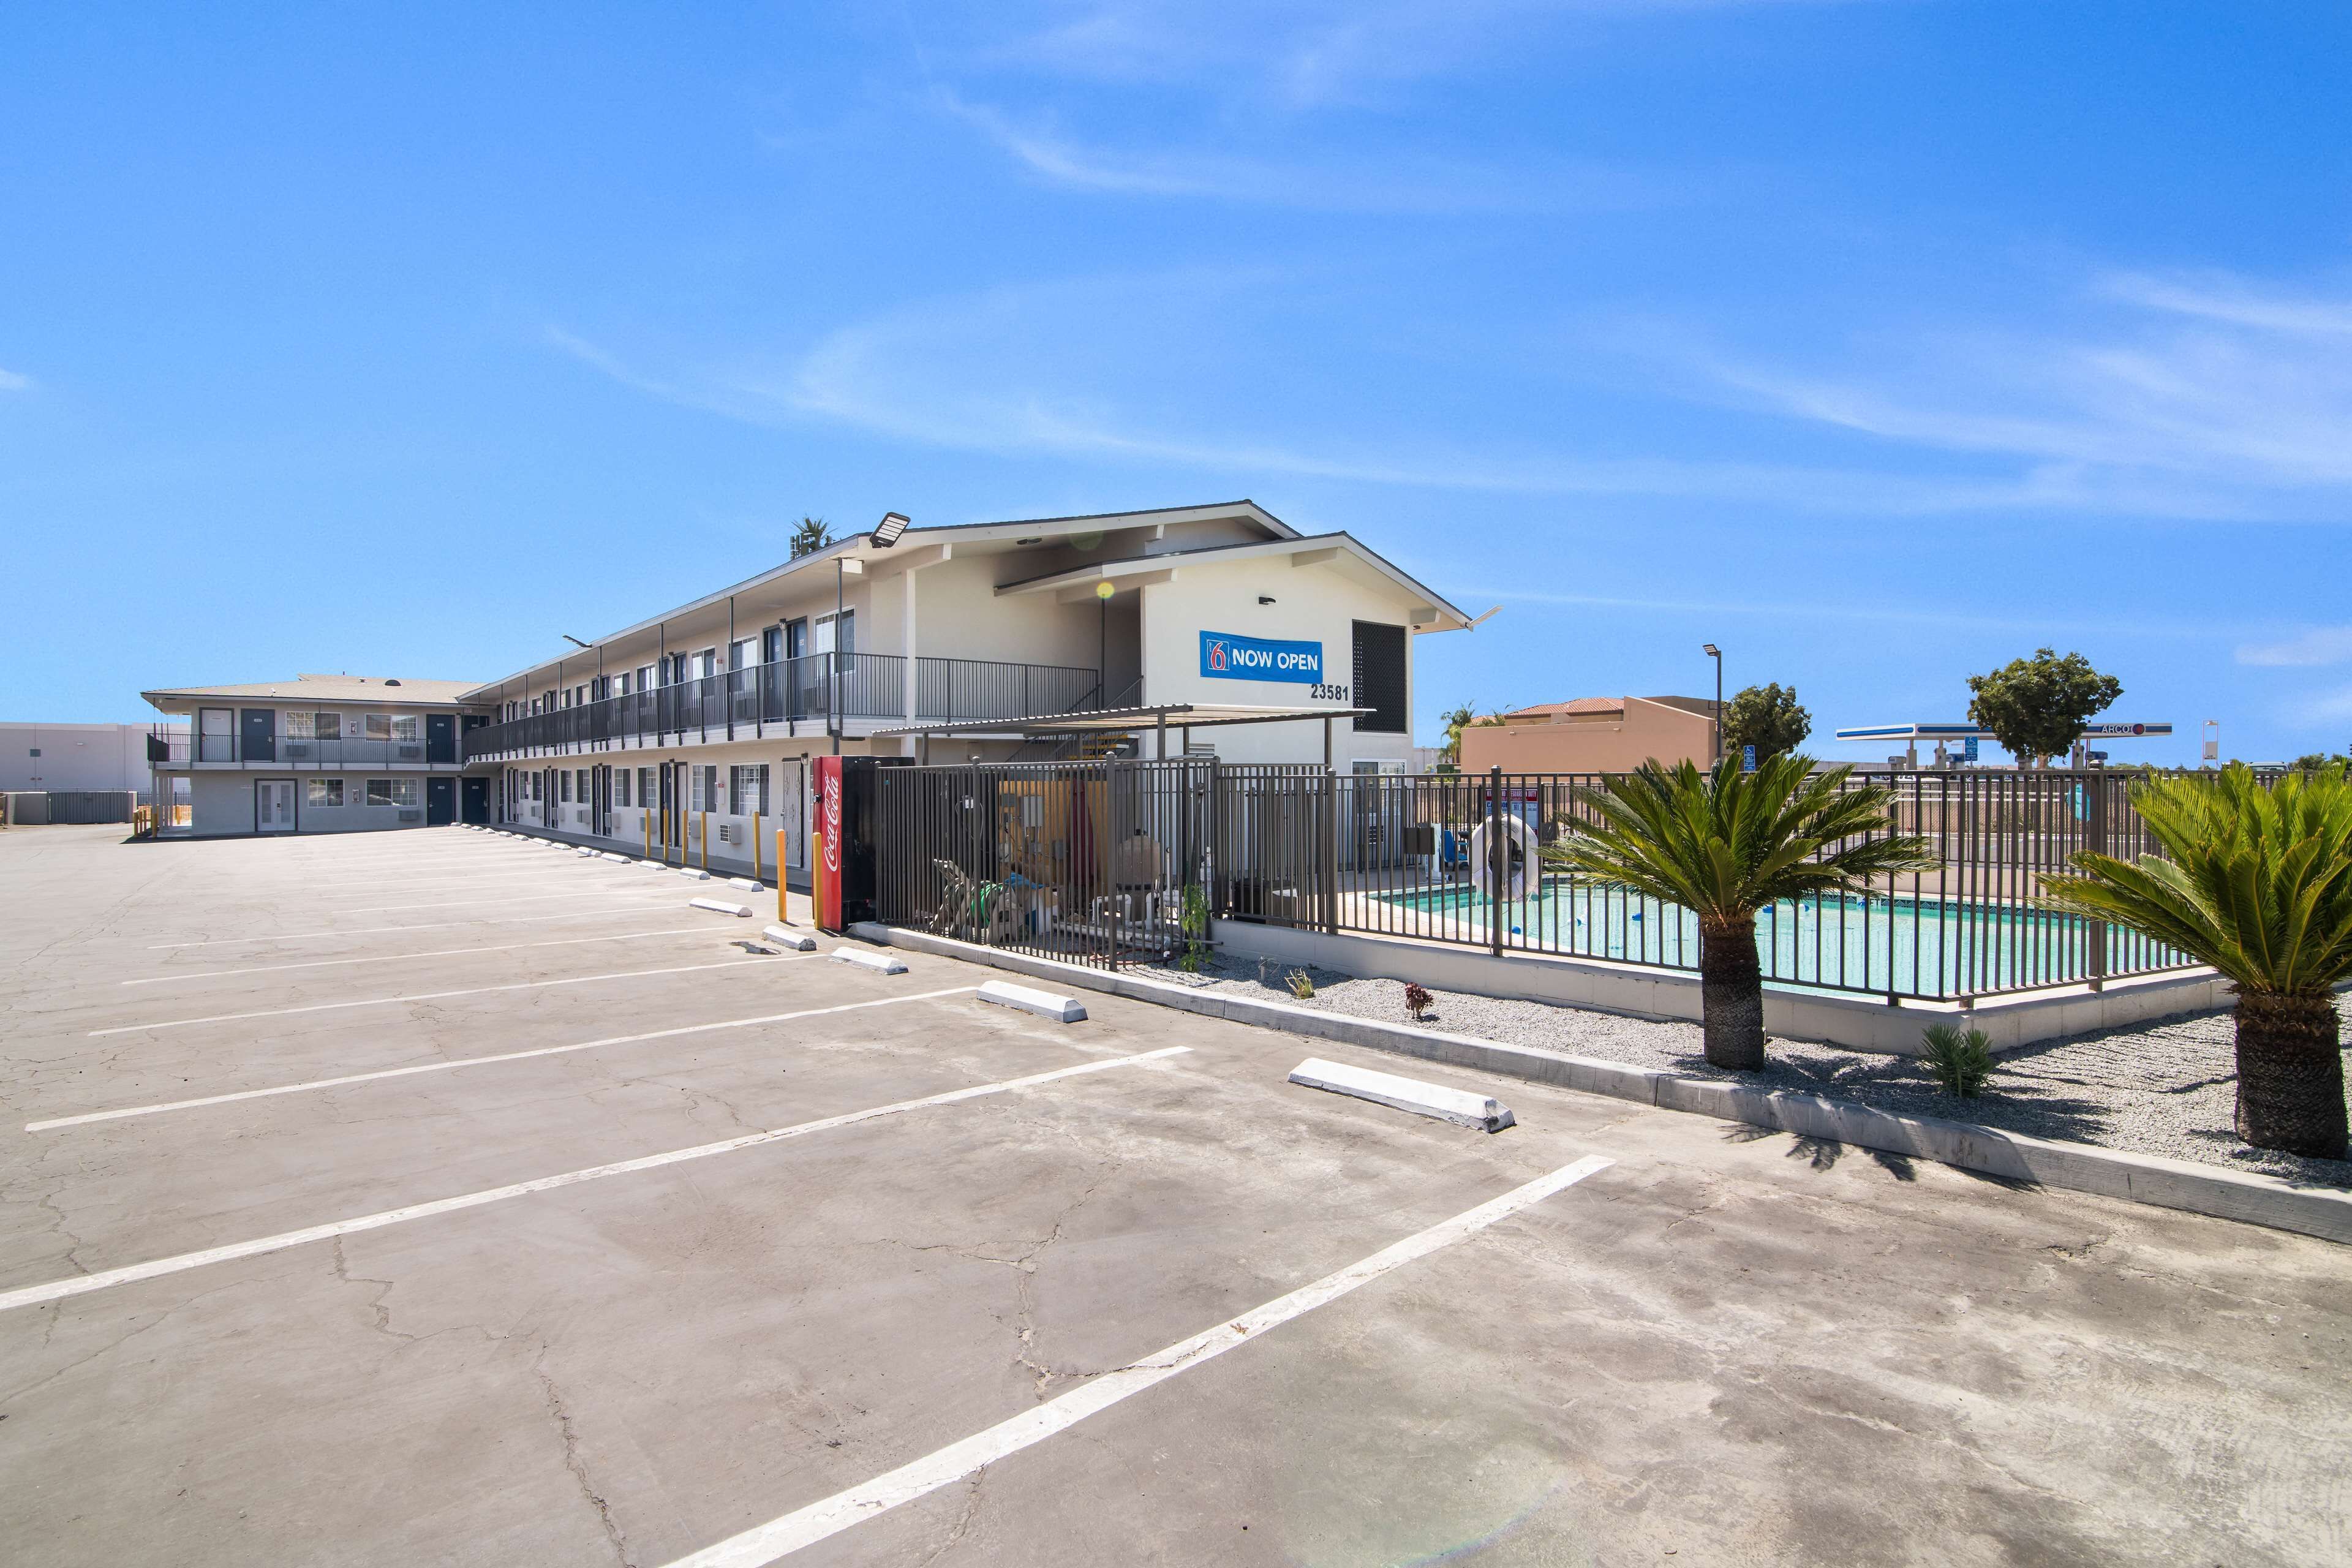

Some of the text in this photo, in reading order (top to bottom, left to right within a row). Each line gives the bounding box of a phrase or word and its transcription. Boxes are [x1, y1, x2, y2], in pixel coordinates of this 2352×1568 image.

[1210, 642, 1226, 670] 6
[1232, 648, 1317, 671] NOW OPEN
[1311, 683, 1348, 701] 23581
[2101, 725, 2130, 733] ARCO
[824, 769, 839, 872] Coca-Cola
